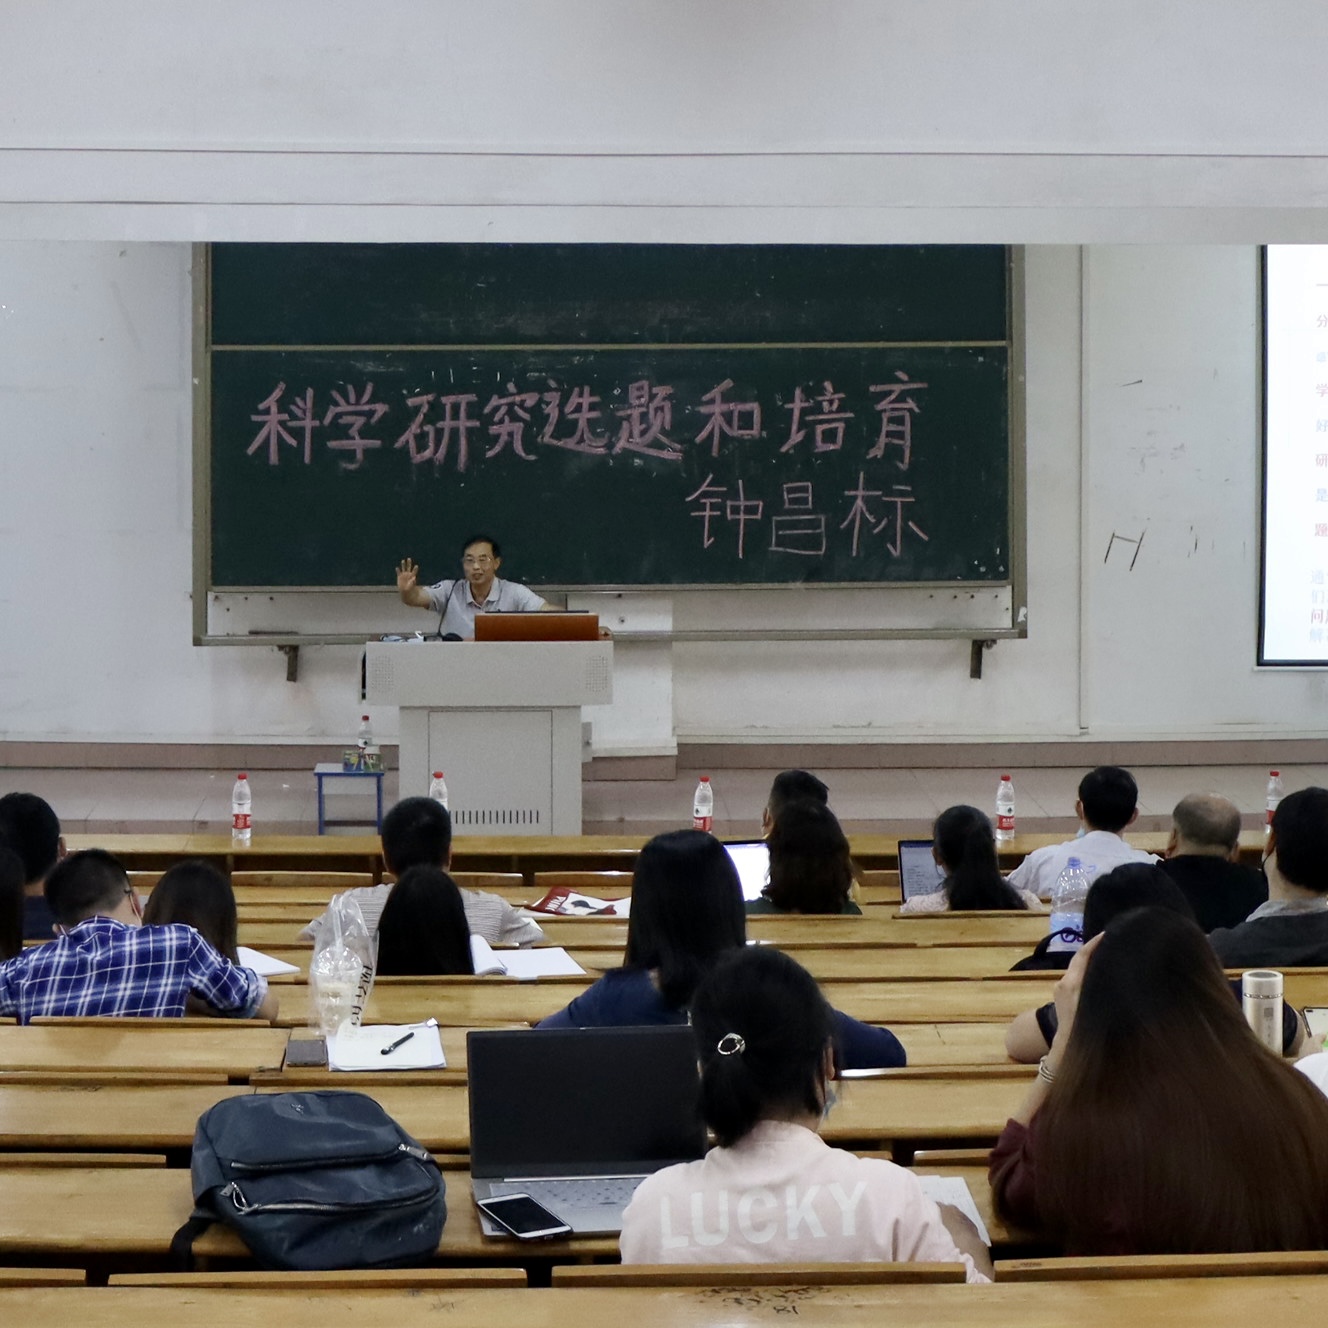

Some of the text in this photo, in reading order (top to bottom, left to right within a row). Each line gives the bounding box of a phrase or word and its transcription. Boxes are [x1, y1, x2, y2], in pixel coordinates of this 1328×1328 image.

[246, 372, 929, 471] 科学研究选题和培育
[685, 473, 929, 560] 钟昌标
[660, 1181, 868, 1250] LUCKY
